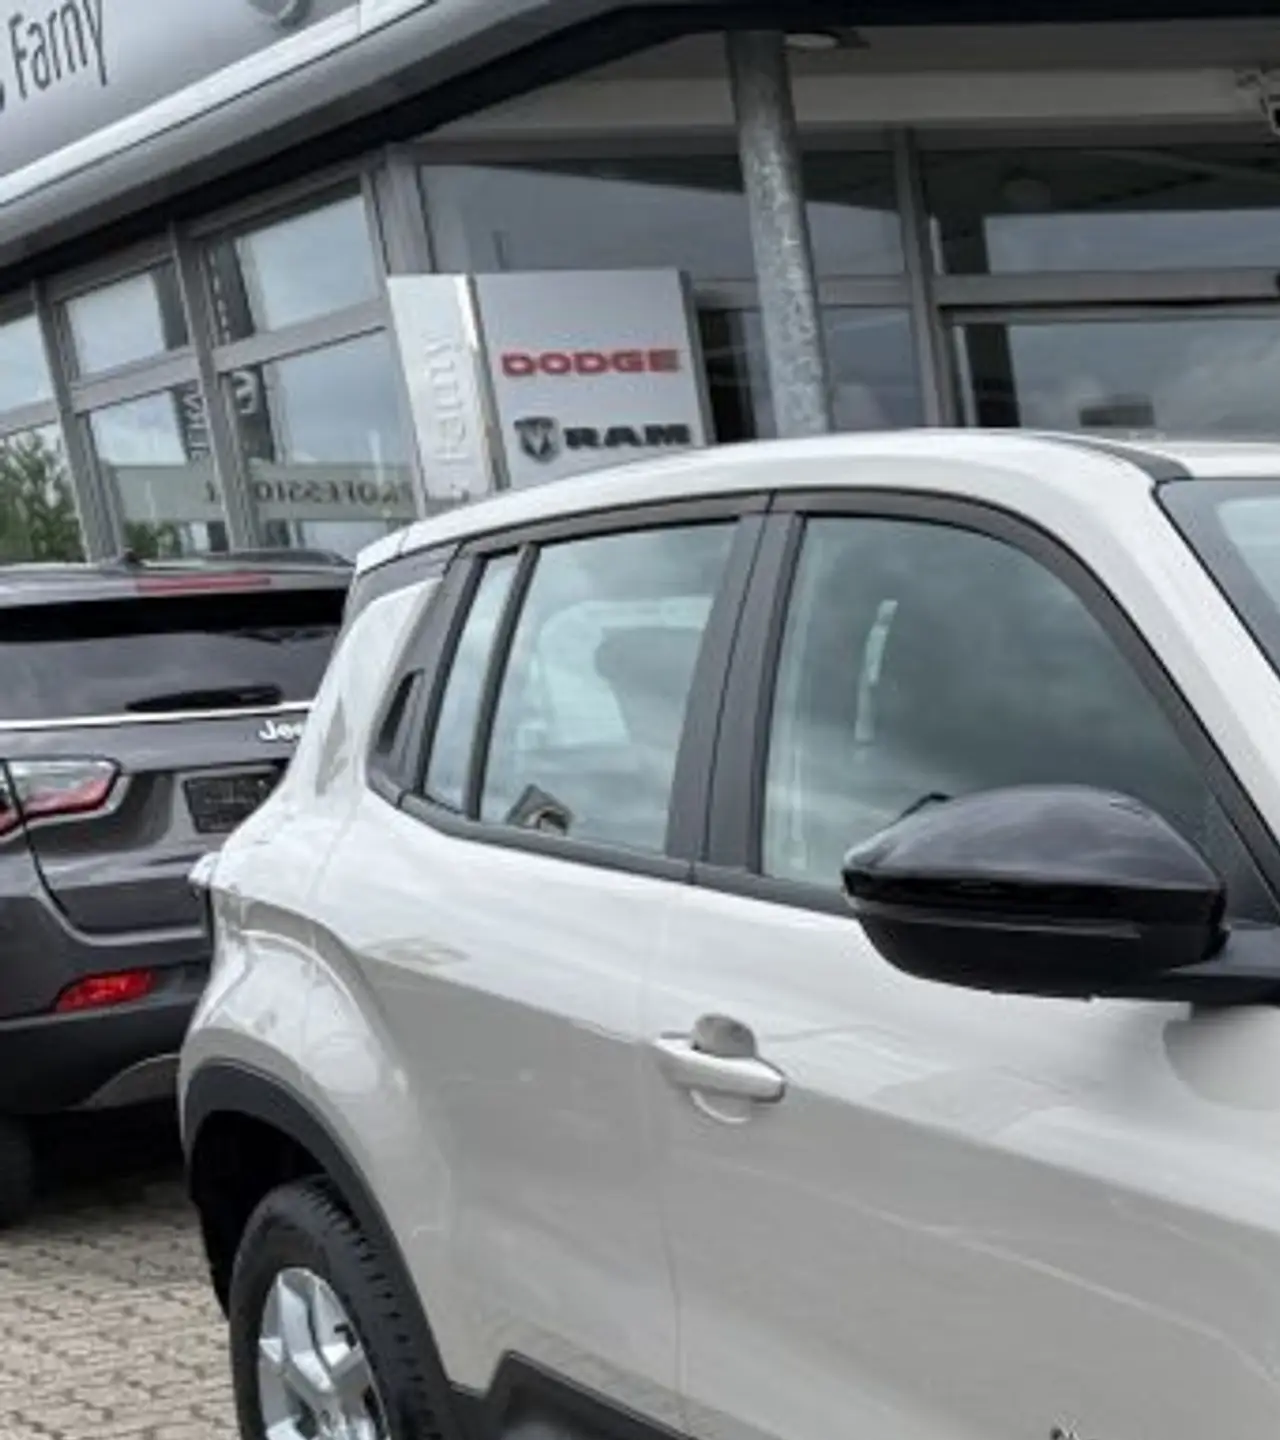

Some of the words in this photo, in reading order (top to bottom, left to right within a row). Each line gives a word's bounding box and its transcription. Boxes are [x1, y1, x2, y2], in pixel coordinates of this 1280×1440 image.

[8, 0, 107, 100] Farny
[502, 348, 679, 377] DODGE
[563, 423, 692, 449] RAM
